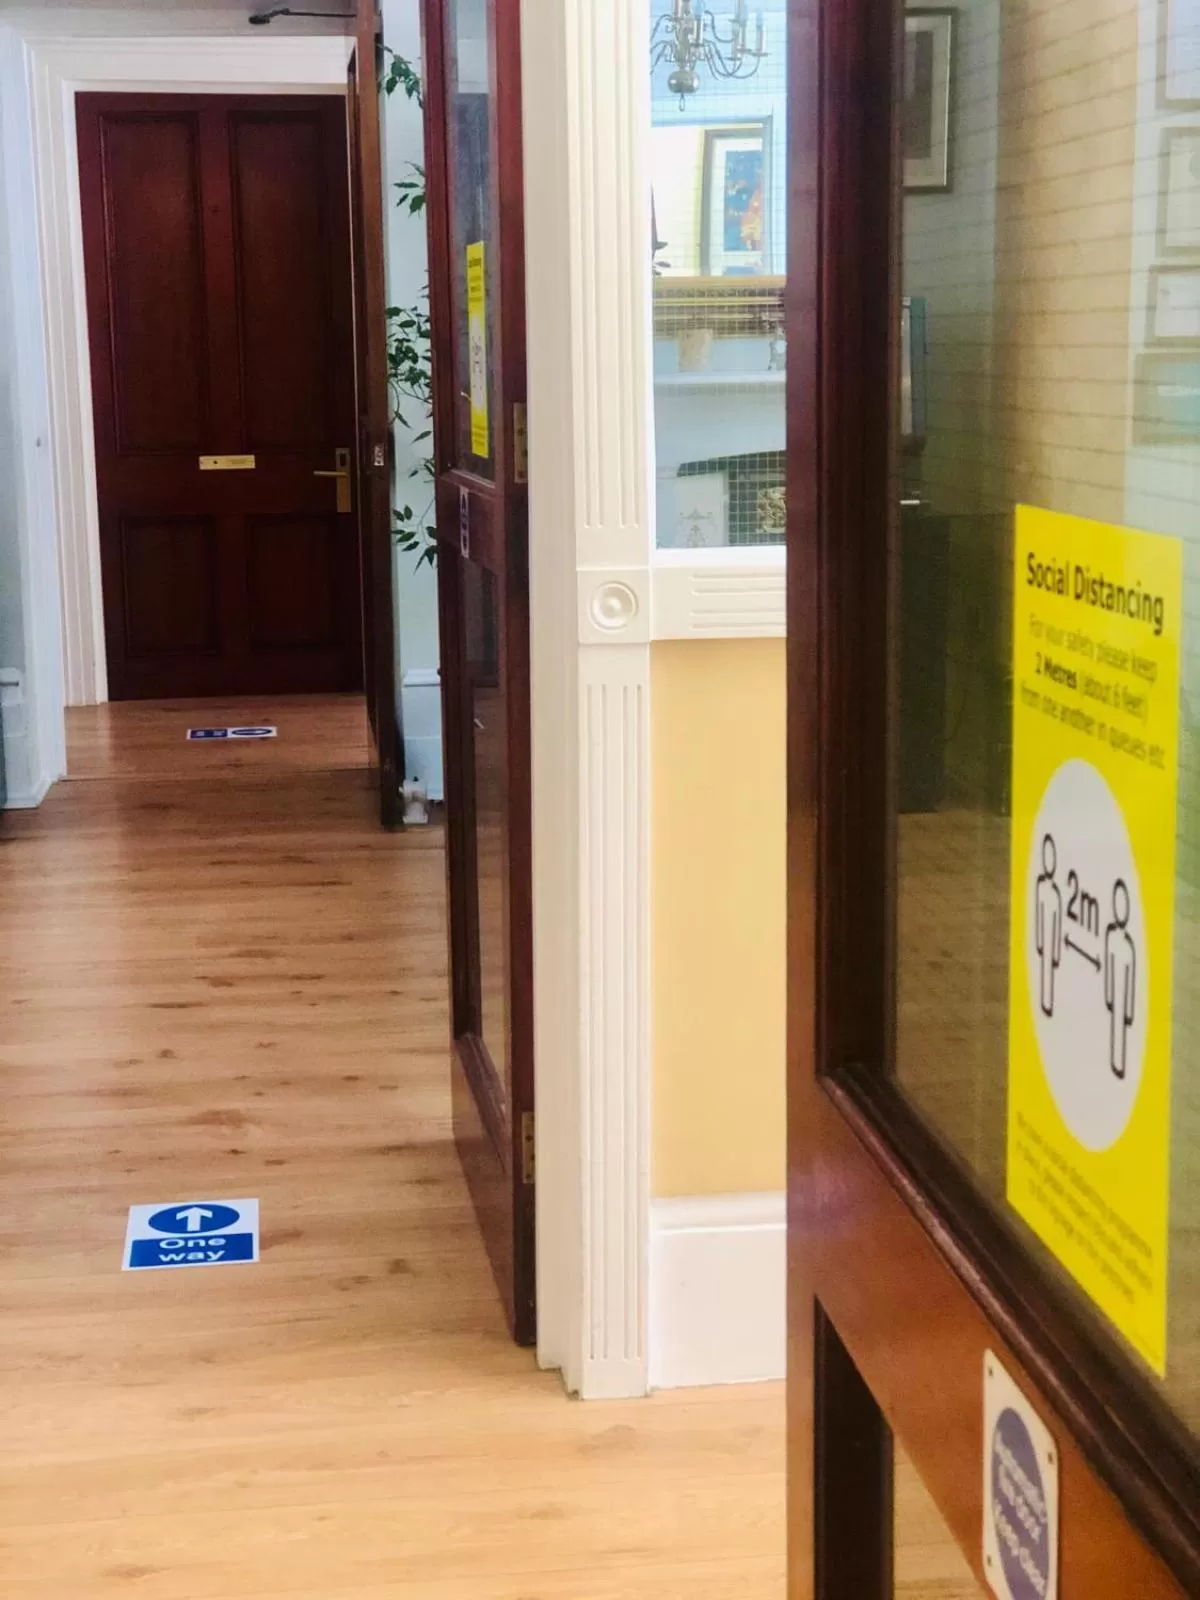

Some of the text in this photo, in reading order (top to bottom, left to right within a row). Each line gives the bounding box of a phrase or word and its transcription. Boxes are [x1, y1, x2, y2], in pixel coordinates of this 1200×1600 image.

[1027, 551, 1164, 636] Social Distancing
[1066, 869, 1099, 936] 2m
[158, 1250, 225, 1262] way
